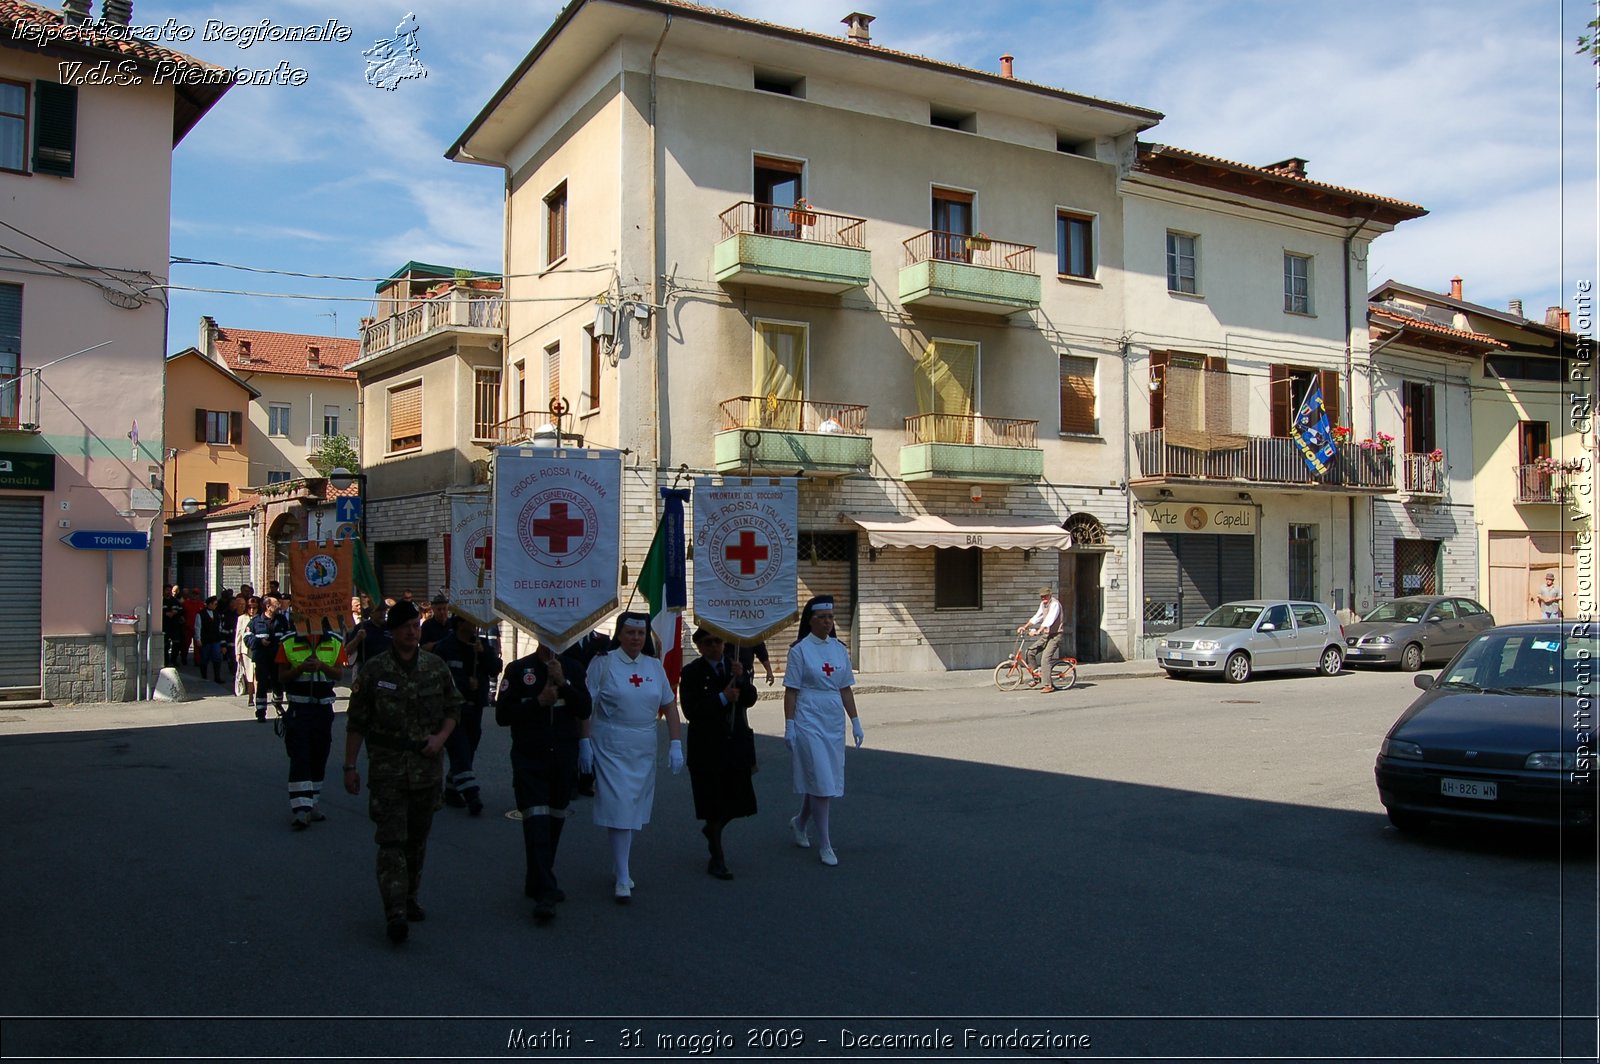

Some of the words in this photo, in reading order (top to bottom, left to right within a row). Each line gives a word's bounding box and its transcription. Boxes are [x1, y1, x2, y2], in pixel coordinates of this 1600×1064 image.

[0, 476, 40, 485] onella
[510, 473, 538, 498] CROCE
[540, 467, 571, 478] ROSSA
[574, 469, 607, 498] ITALIANA
[477, 509, 493, 518] ROS
[1150, 508, 1178, 524] Arte
[1214, 511, 1250, 528] Capelli
[520, 501, 538, 556] CONVENZIONE
[533, 497, 543, 505] DI
[542, 490, 577, 501] GINEVRA
[577, 498, 588, 510] 22
[585, 507, 596, 541] AGOSTO
[697, 511, 721, 547] CROCE
[720, 500, 759, 516] ROSSA
[761, 503, 795, 545] ITALIANA
[733, 516, 769, 532] GINEVRA
[94, 536, 132, 545] TORINO
[768, 530, 776, 540] 22
[966, 535, 983, 545] BAR
[711, 534, 740, 587] CONVENZIONE
[770, 542, 780, 572] AGOSTO
[514, 580, 587, 589] DELEGAZIONE
[591, 580, 601, 588] DI
[538, 597, 579, 608] MATHI
[707, 599, 750, 607] COMITATO
[753, 595, 783, 607] LOCALE
[729, 609, 765, 619] FIANO
[1442, 783, 1454, 793] AH
[1459, 784, 1478, 795] 826
[1483, 786, 1496, 797] WN
